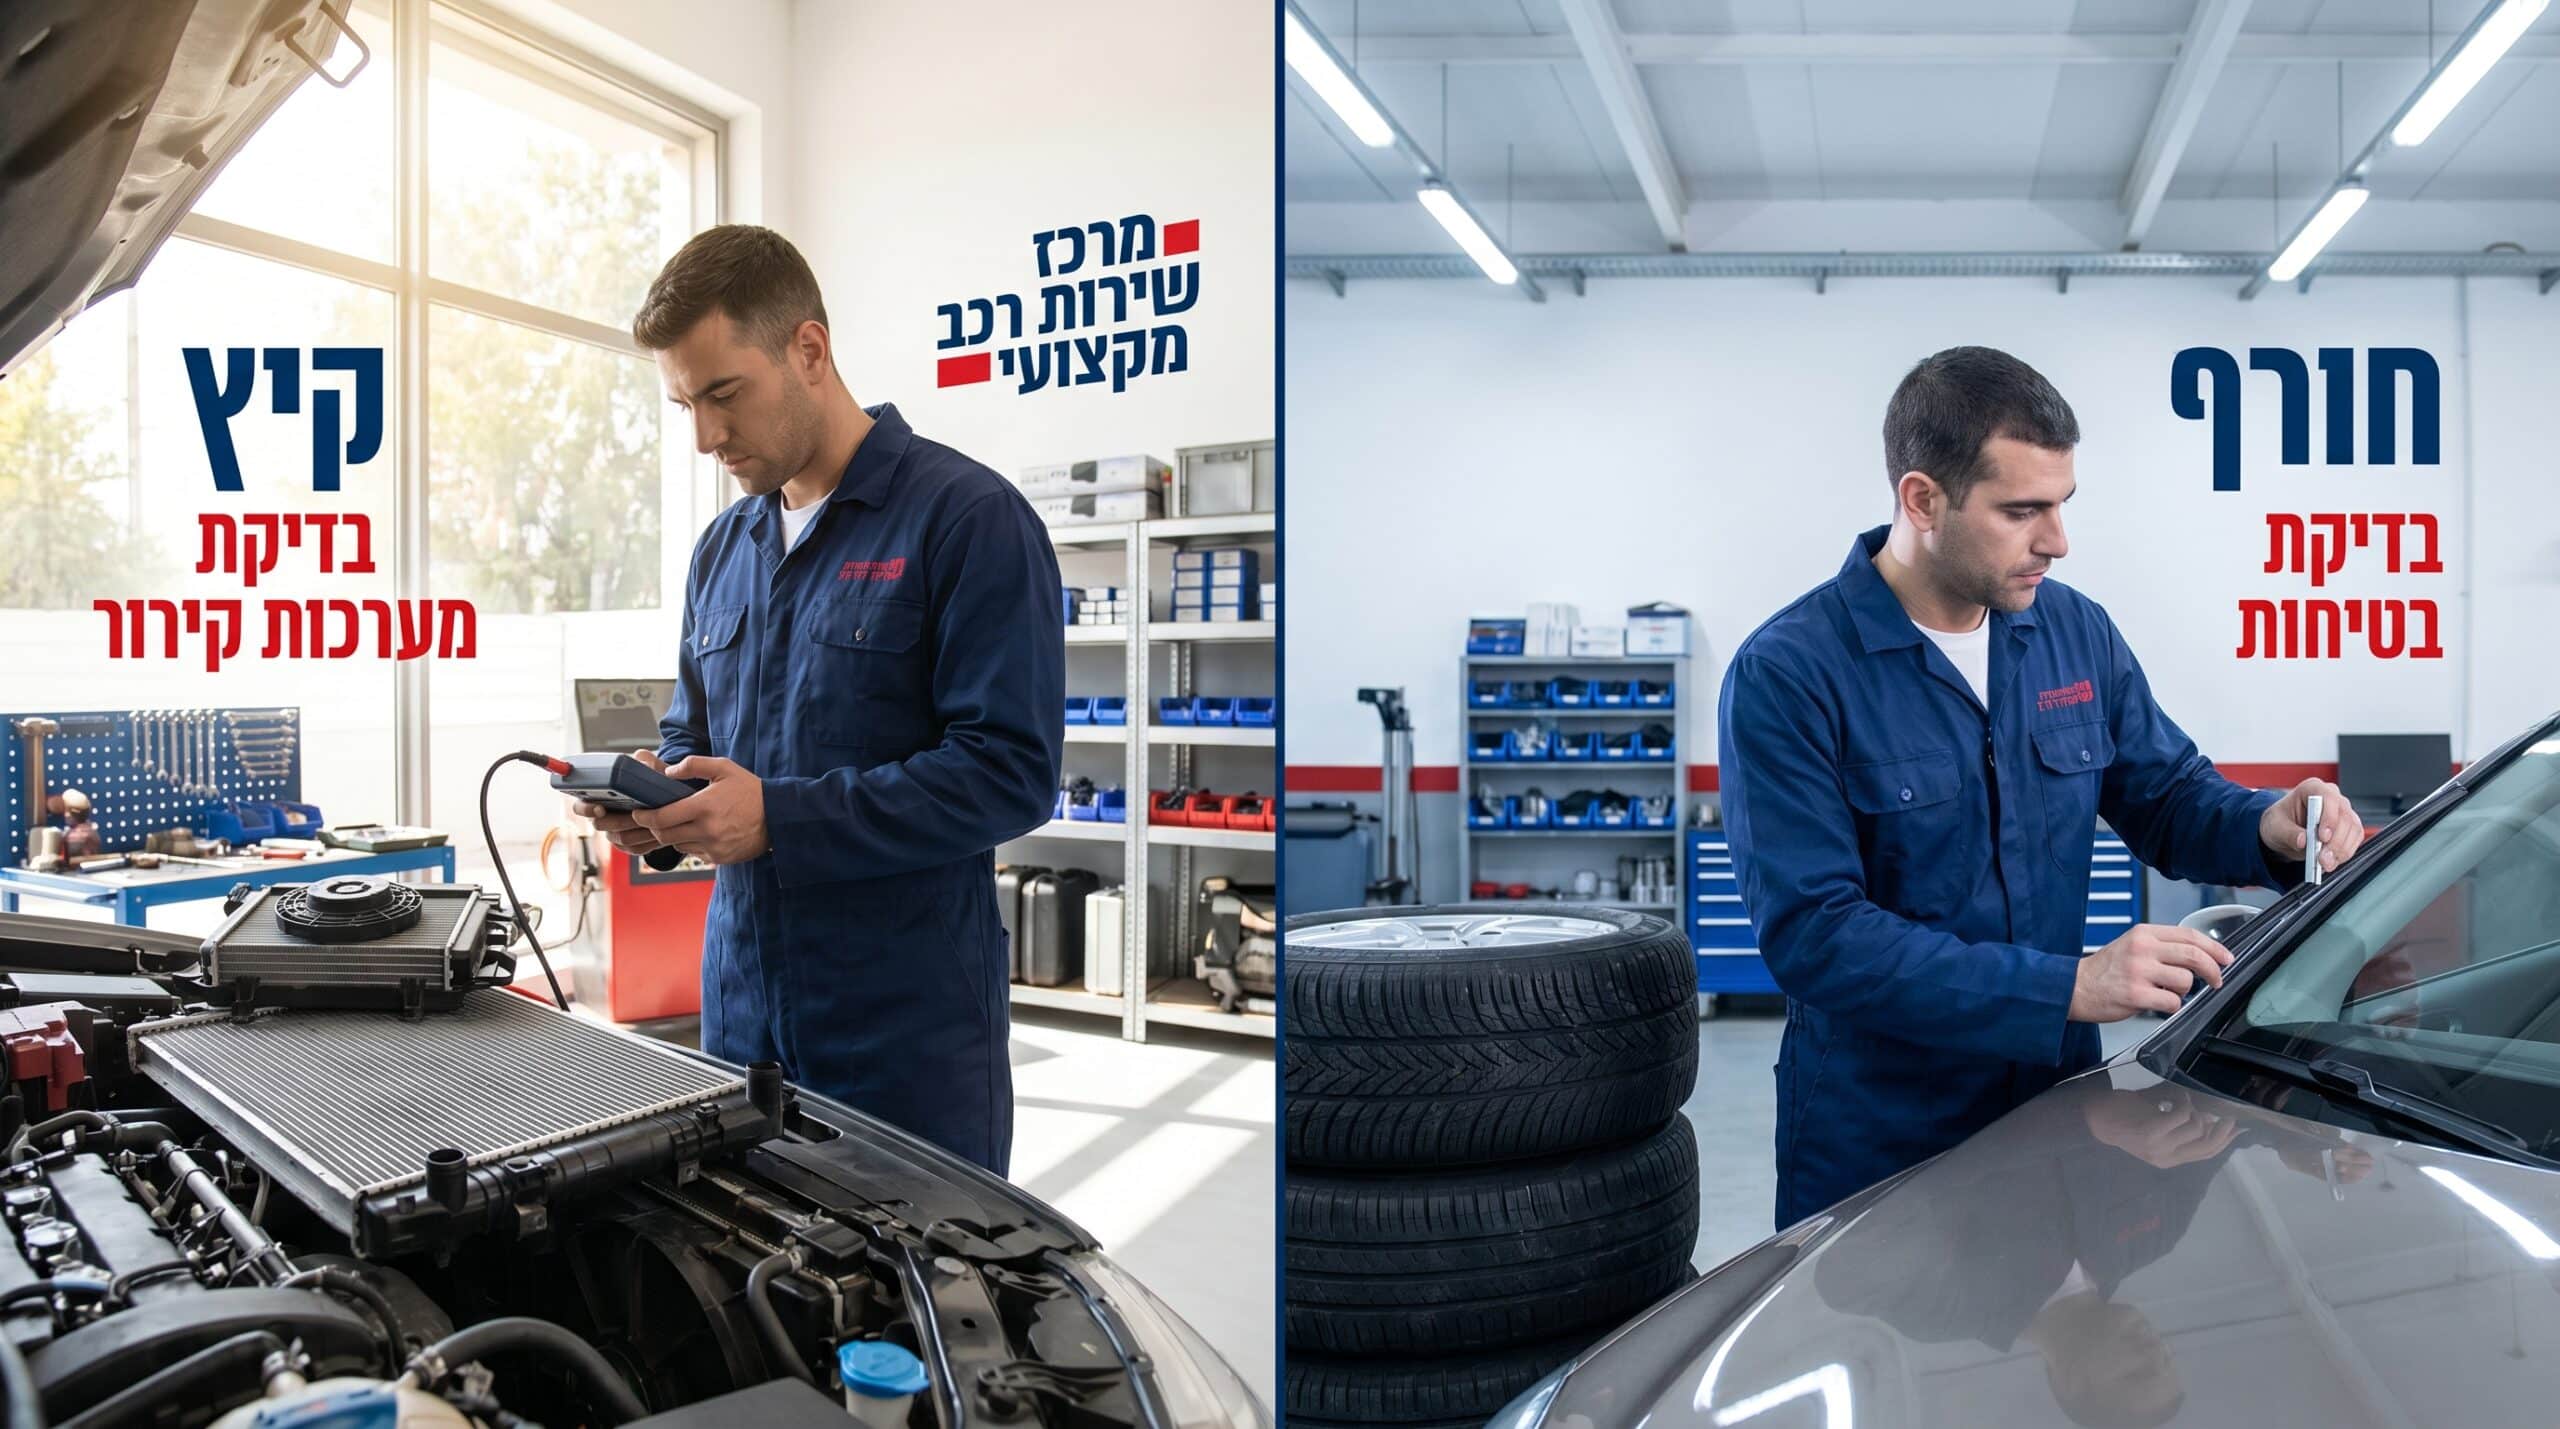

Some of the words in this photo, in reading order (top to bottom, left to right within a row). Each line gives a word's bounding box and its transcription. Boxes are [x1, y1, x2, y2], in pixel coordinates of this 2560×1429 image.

[1033, 214, 1156, 278] מרכז
[937, 293, 1022, 350] רכב
[1038, 261, 1200, 335] שירות
[998, 324, 1188, 395] מקצועי
